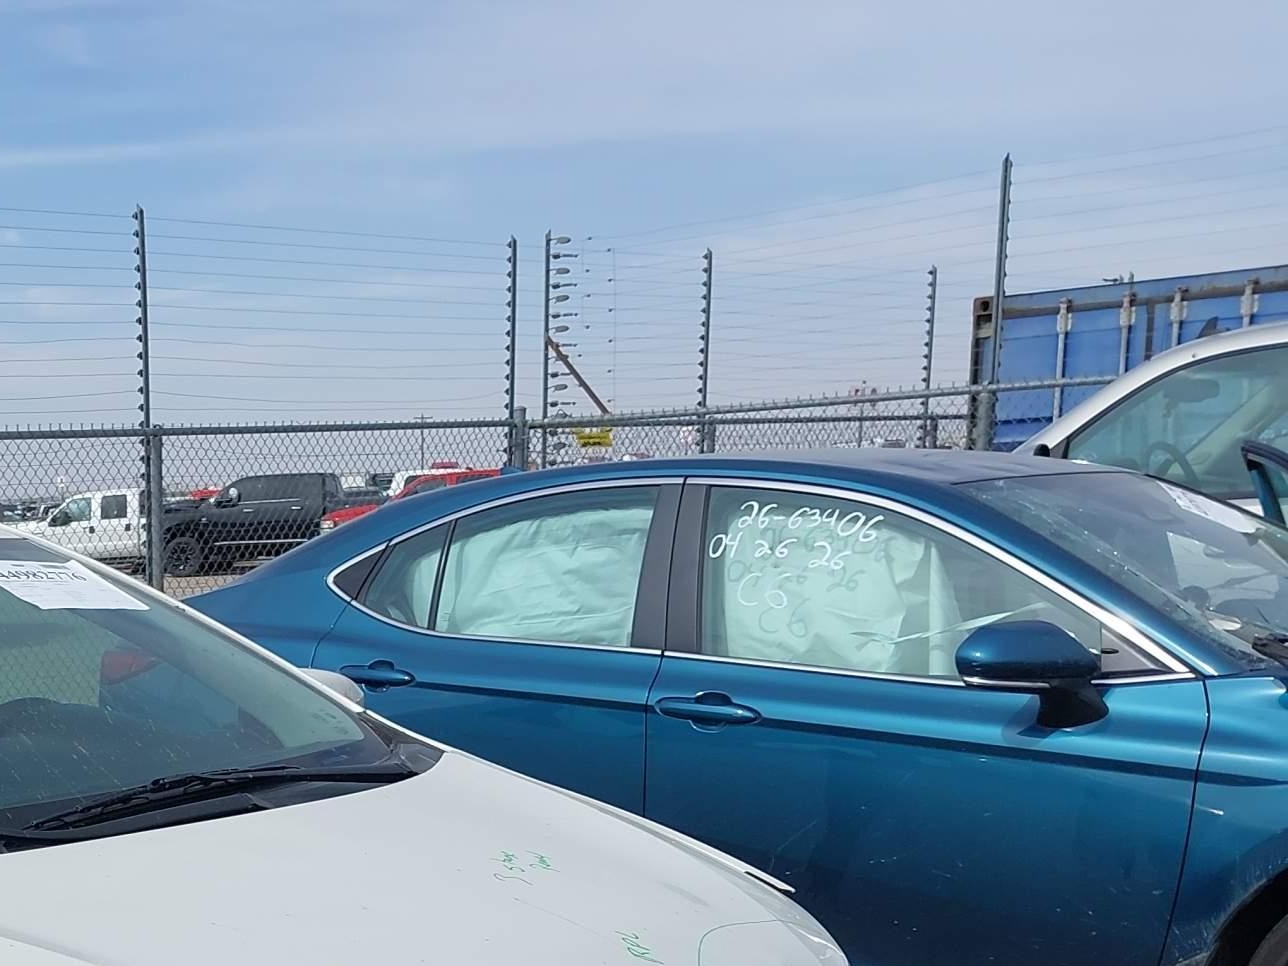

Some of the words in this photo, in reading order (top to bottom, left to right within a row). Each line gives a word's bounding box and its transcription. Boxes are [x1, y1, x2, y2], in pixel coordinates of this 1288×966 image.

[737, 501, 884, 542] 26-63406
[709, 532, 744, 558] 04
[754, 538, 797, 558] 26
[808, 541, 852, 570] 26
